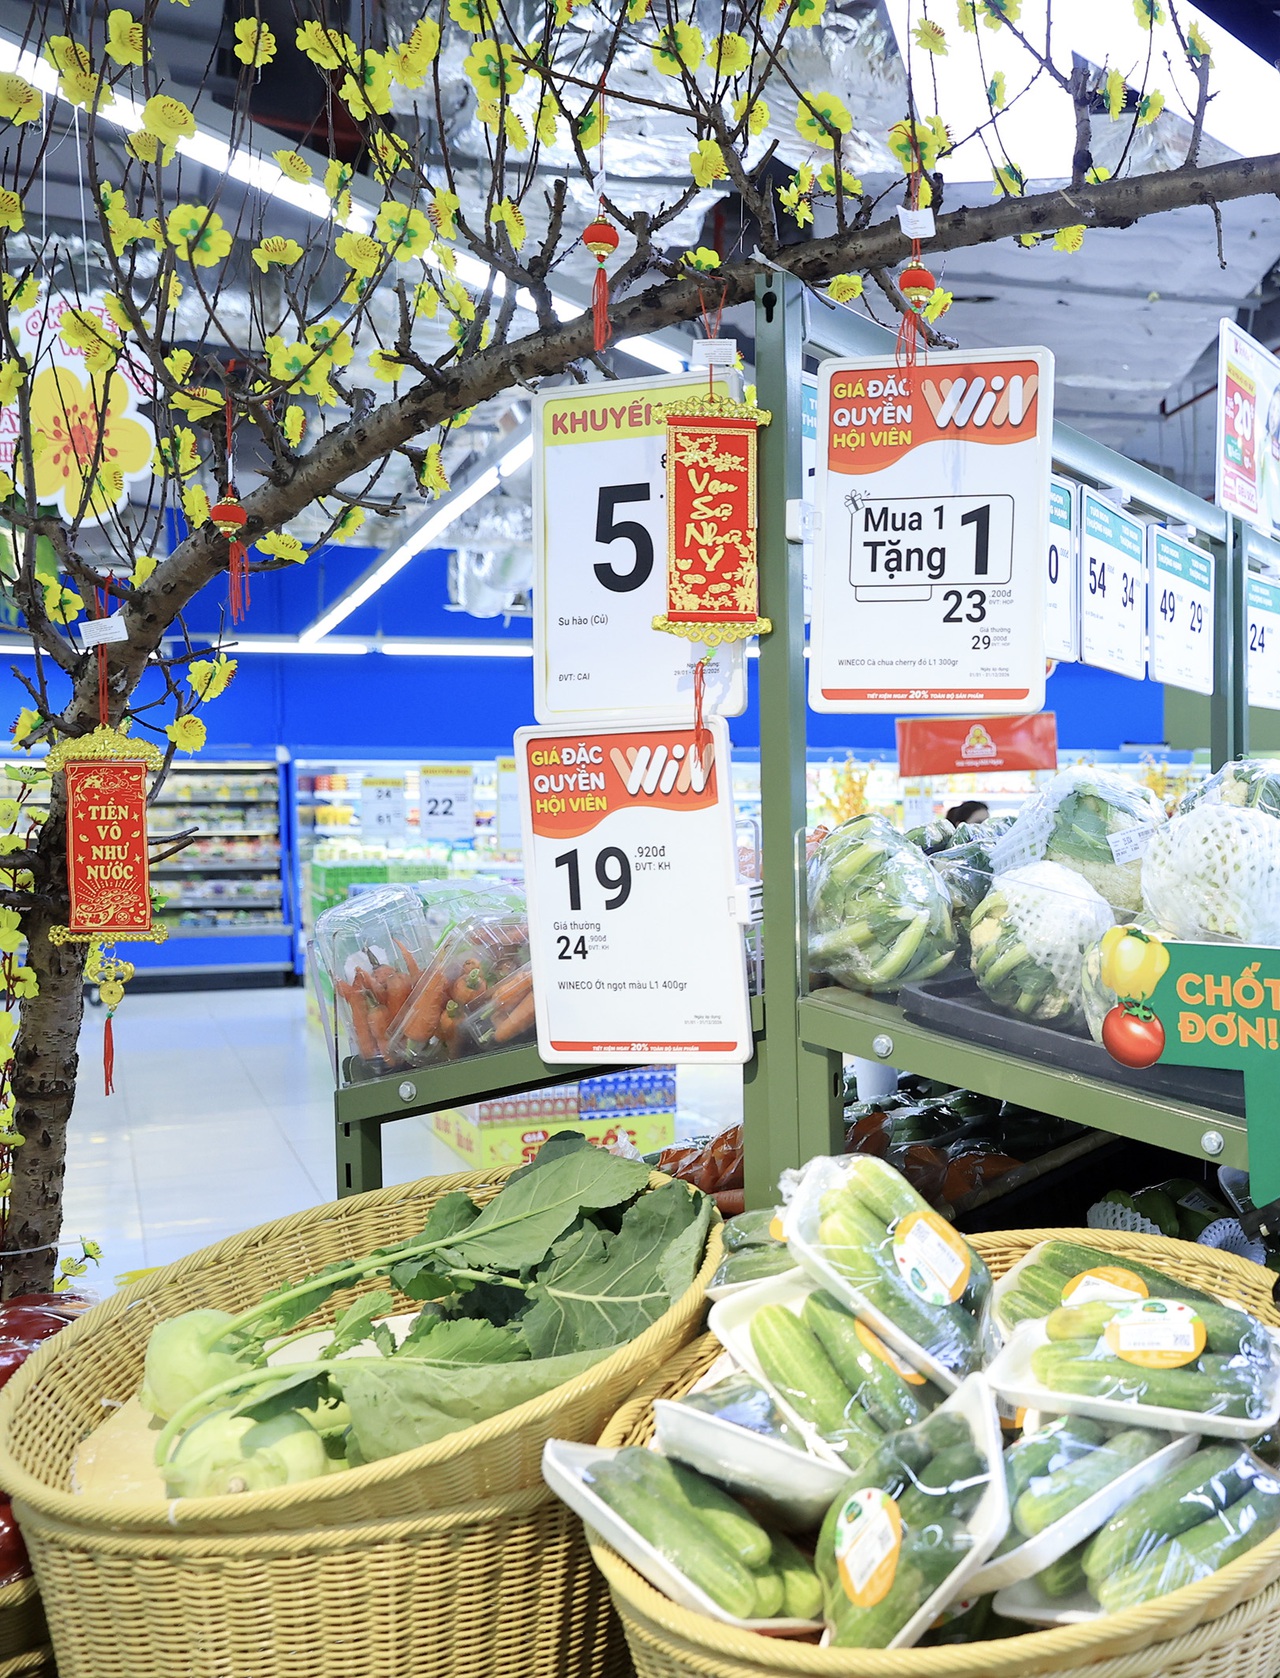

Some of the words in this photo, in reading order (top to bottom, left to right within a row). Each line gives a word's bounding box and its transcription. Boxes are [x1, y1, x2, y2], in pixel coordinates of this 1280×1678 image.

[833, 379, 865, 399] GIÁ
[867, 374, 912, 401] ĐẶC
[833, 400, 912, 427] QUYỀN
[833, 428, 865, 451] HỘI
[870, 427, 912, 447] VIÊN
[864, 507, 922, 532] Mua
[933, 505, 943, 530] 1
[593, 482, 654, 592] 5
[863, 539, 946, 580] Tặng
[961, 503, 990, 576] 1
[698, 545, 725, 572] Ý
[1089, 557, 1106, 599] 54
[1122, 572, 1134, 611] 34
[942, 589, 986, 623] 23
[1160, 588, 1175, 623] 49
[1190, 601, 1202, 633] 29
[558, 617, 570, 627] Su
[572, 615, 588, 627] hào
[590, 613, 608, 627] (Củ)
[971, 635, 991, 650] 29
[1249, 623, 1265, 653] 24
[867, 658, 876, 666] Cà
[895, 658, 916, 668] cherry
[938, 658, 958, 668] 300gr
[558, 673, 576, 682] ĐVT:
[577, 672, 590, 681] CAI
[908, 690, 928, 699] 20%
[531, 746, 560, 767] GIÁ
[561, 743, 603, 767] ĐẶC
[533, 766, 606, 793] QUYỀN
[88, 798, 130, 821] TIỀN
[427, 798, 454, 817] 22
[536, 796, 566, 817] HỘI
[569, 793, 608, 812] VIÊN
[97, 821, 122, 841] VÔ
[91, 842, 130, 861] NHƯ
[634, 846, 666, 858] .920đ
[86, 861, 134, 881] NƯỚC
[635, 862, 656, 871] ĐVT:
[658, 861, 671, 871] KH
[554, 846, 632, 911] 19
[553, 921, 568, 931] Giá
[570, 921, 601, 932] thường
[556, 935, 588, 960] 24
[558, 981, 593, 990] WINECO
[595, 979, 605, 990] Ớt
[606, 981, 626, 992] ngọt
[628, 980, 647, 990] màu
[649, 980, 659, 989] L1
[662, 980, 687, 991] 400gr
[630, 1043, 648, 1051] 20%
